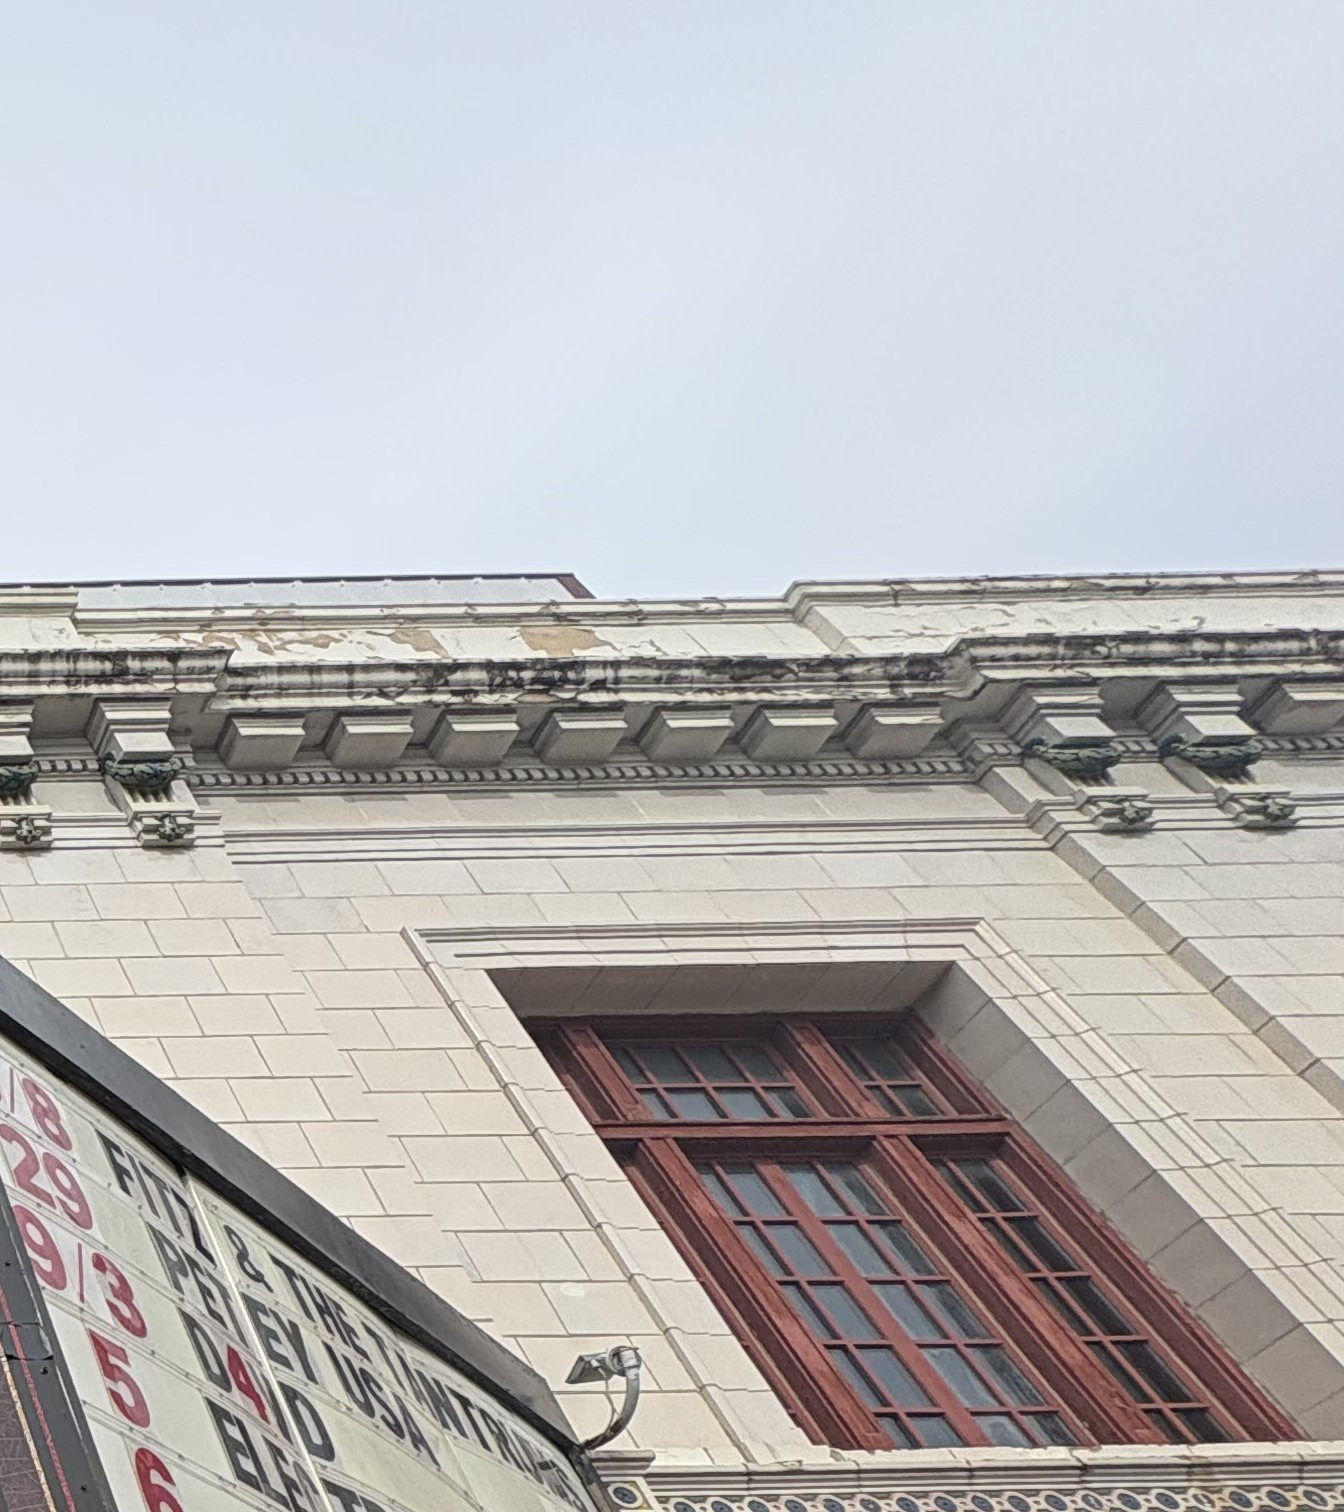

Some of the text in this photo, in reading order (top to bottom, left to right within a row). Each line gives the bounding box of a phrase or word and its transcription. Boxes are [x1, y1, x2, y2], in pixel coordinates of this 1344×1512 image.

[11, 1205, 336, 1462] 9/3 D4VD
[89, 1328, 151, 1428] 5
[146, 1221, 319, 1386] PETEY
[322, 1340, 442, 1471] USA
[223, 1224, 274, 1293] &
[267, 1251, 373, 1365] THE
